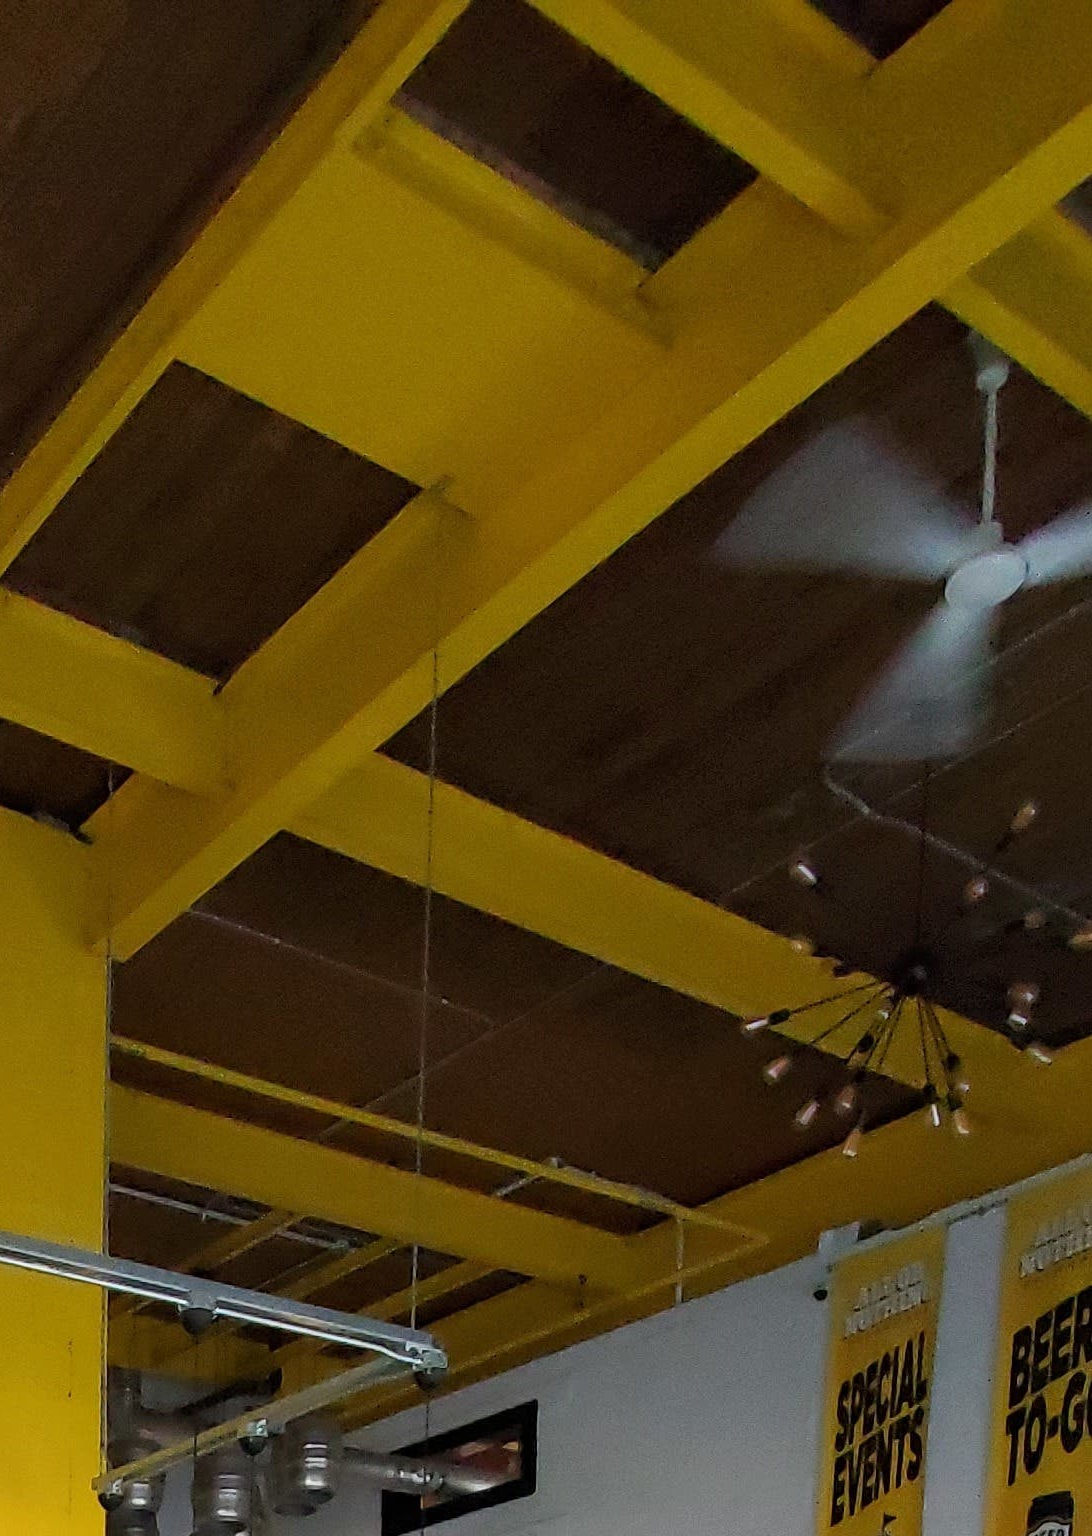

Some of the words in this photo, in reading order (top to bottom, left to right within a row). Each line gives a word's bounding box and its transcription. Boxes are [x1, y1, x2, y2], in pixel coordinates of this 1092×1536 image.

[835, 1330, 928, 1453] SPECIAL
[1009, 1285, 1092, 1410] BEER
[830, 1404, 924, 1527] EVENTS
[1006, 1370, 1092, 1486] TO-G
